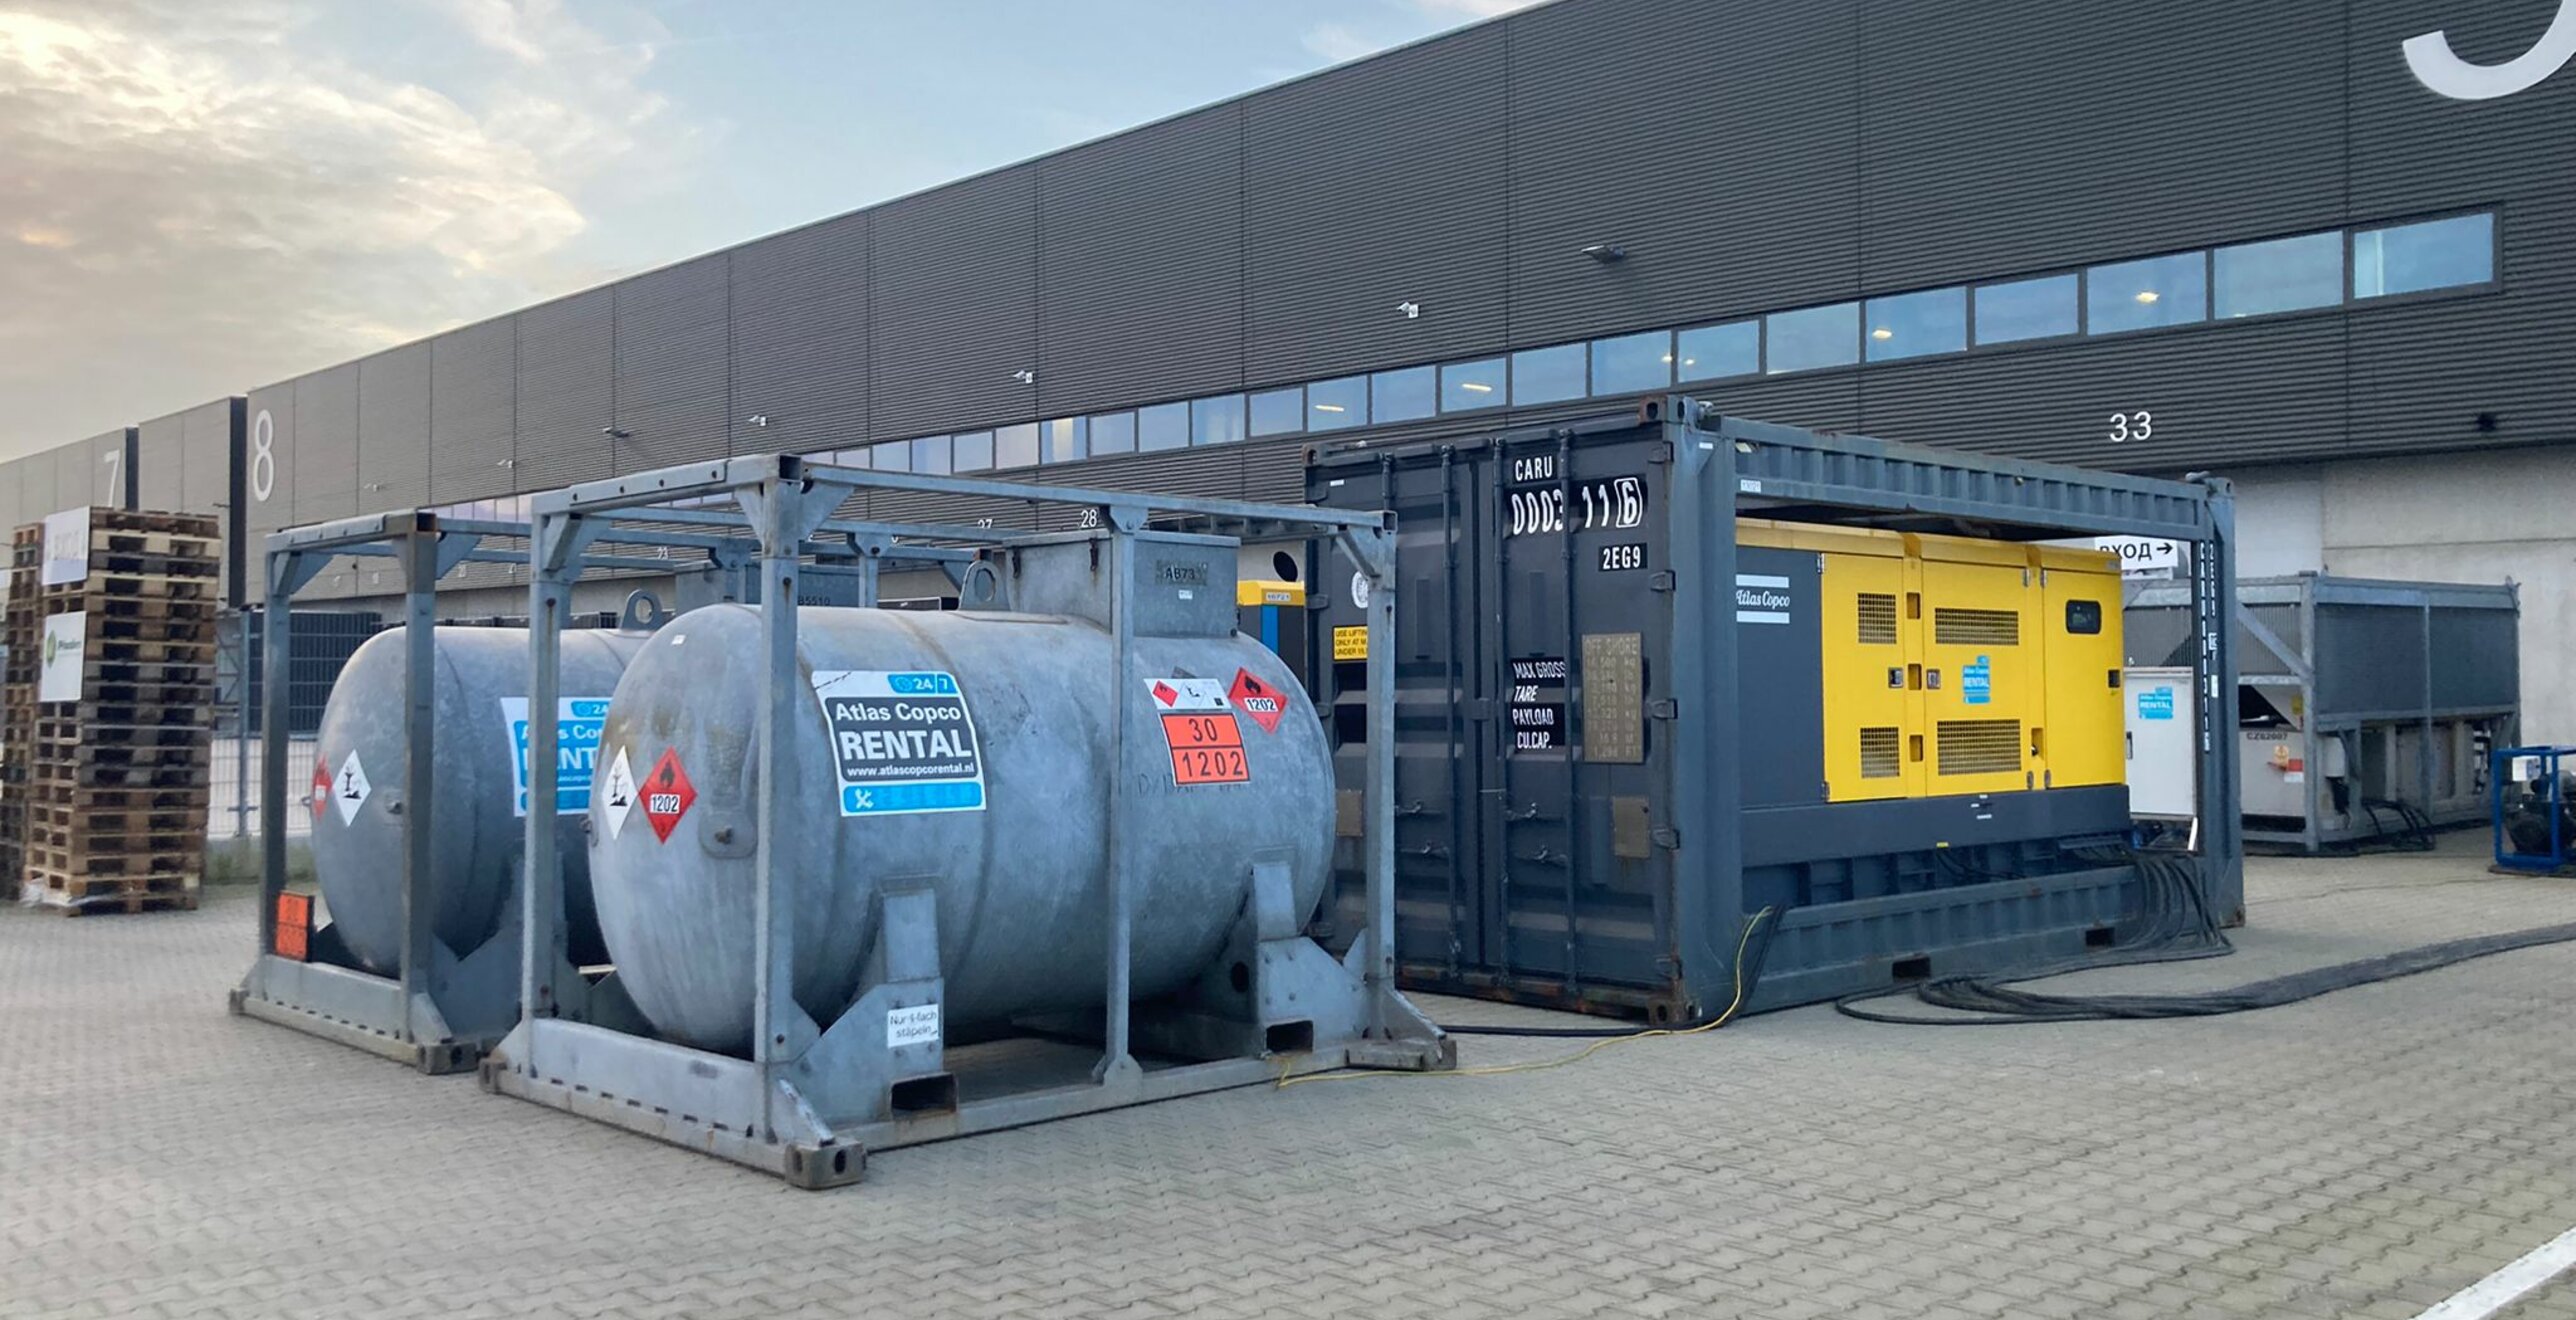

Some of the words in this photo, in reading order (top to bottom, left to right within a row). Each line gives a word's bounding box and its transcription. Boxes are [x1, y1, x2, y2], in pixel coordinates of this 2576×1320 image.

[2109, 411, 2152, 442] 33
[253, 409, 274, 502] 8
[104, 449, 120, 507] 7
[1515, 455, 1553, 481] CARU
[1081, 508, 1097, 528] 28
[1602, 545, 1641, 570] 2EG9
[1736, 589, 1761, 606] Atlas
[1762, 590, 1790, 610] Copco
[1513, 662, 1536, 679] MAX
[1535, 661, 1566, 678] GROSS
[1246, 698, 1278, 712] 1202
[1514, 685, 1538, 702] TARE
[835, 702, 891, 722] Atlas
[895, 702, 962, 725] Copco
[1512, 708, 1554, 726] PAYLOAD
[1188, 718, 1218, 742] 30
[839, 729, 973, 760] RENTAL
[846, 762, 975, 777] www.atlascopcorental.nl
[1182, 750, 1244, 778] 1202
[652, 795, 679, 812] 1202
